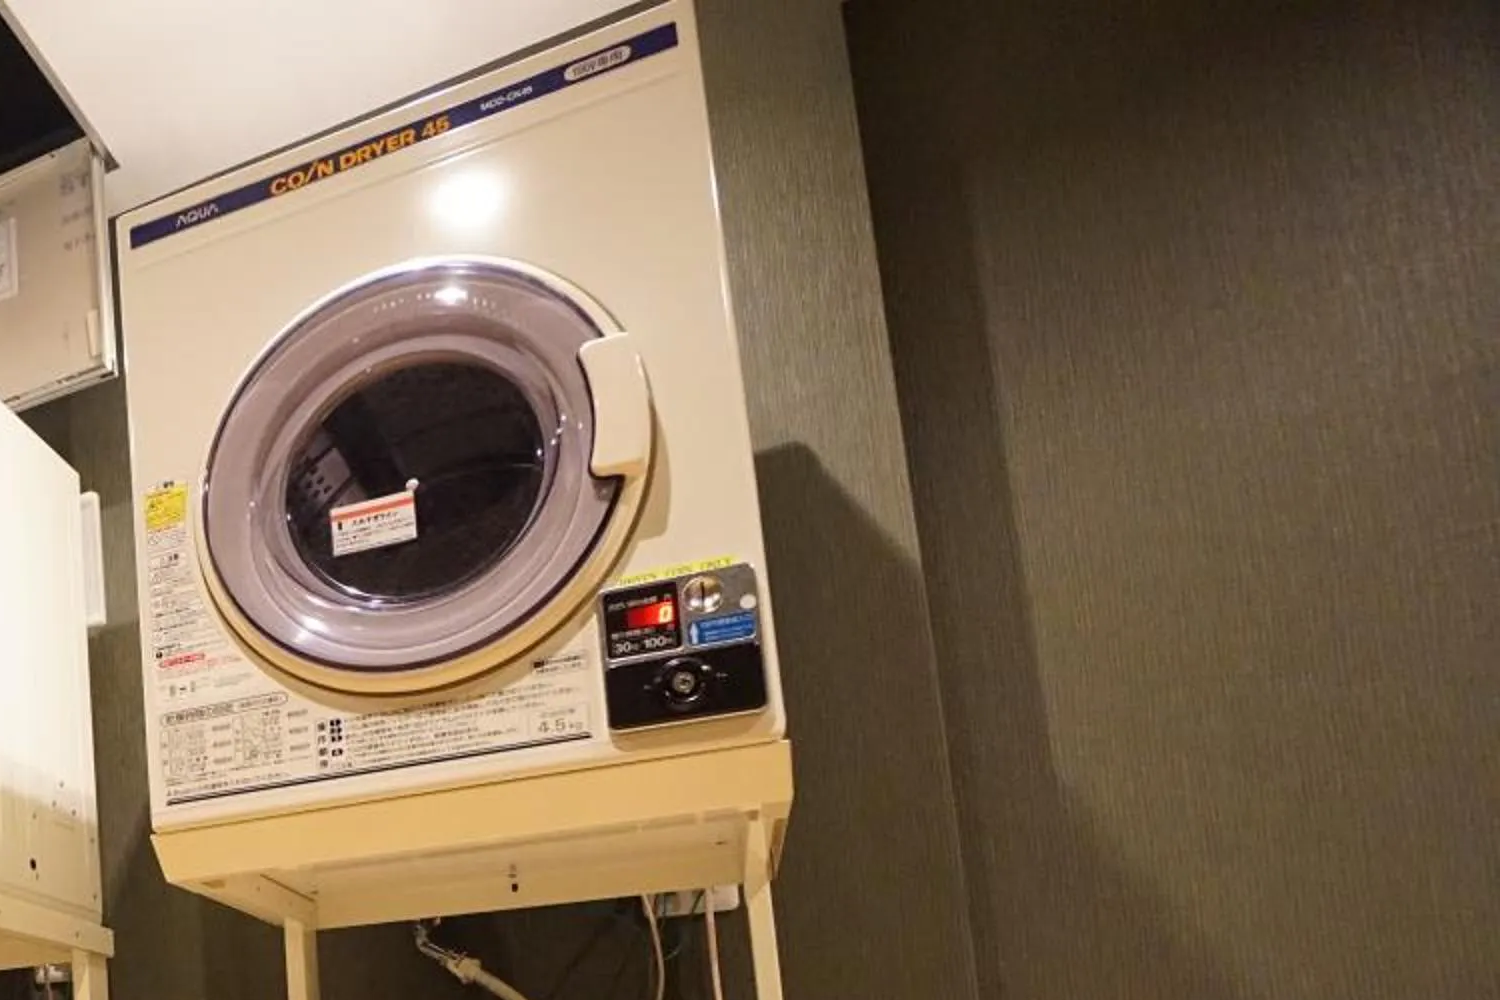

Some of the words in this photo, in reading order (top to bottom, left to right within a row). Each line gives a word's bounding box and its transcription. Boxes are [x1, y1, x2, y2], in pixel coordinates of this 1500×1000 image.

[339, 129, 416, 173] DRYER
[420, 115, 451, 139] 45
[175, 203, 220, 229] AQUA
[659, 603, 674, 623] 0
